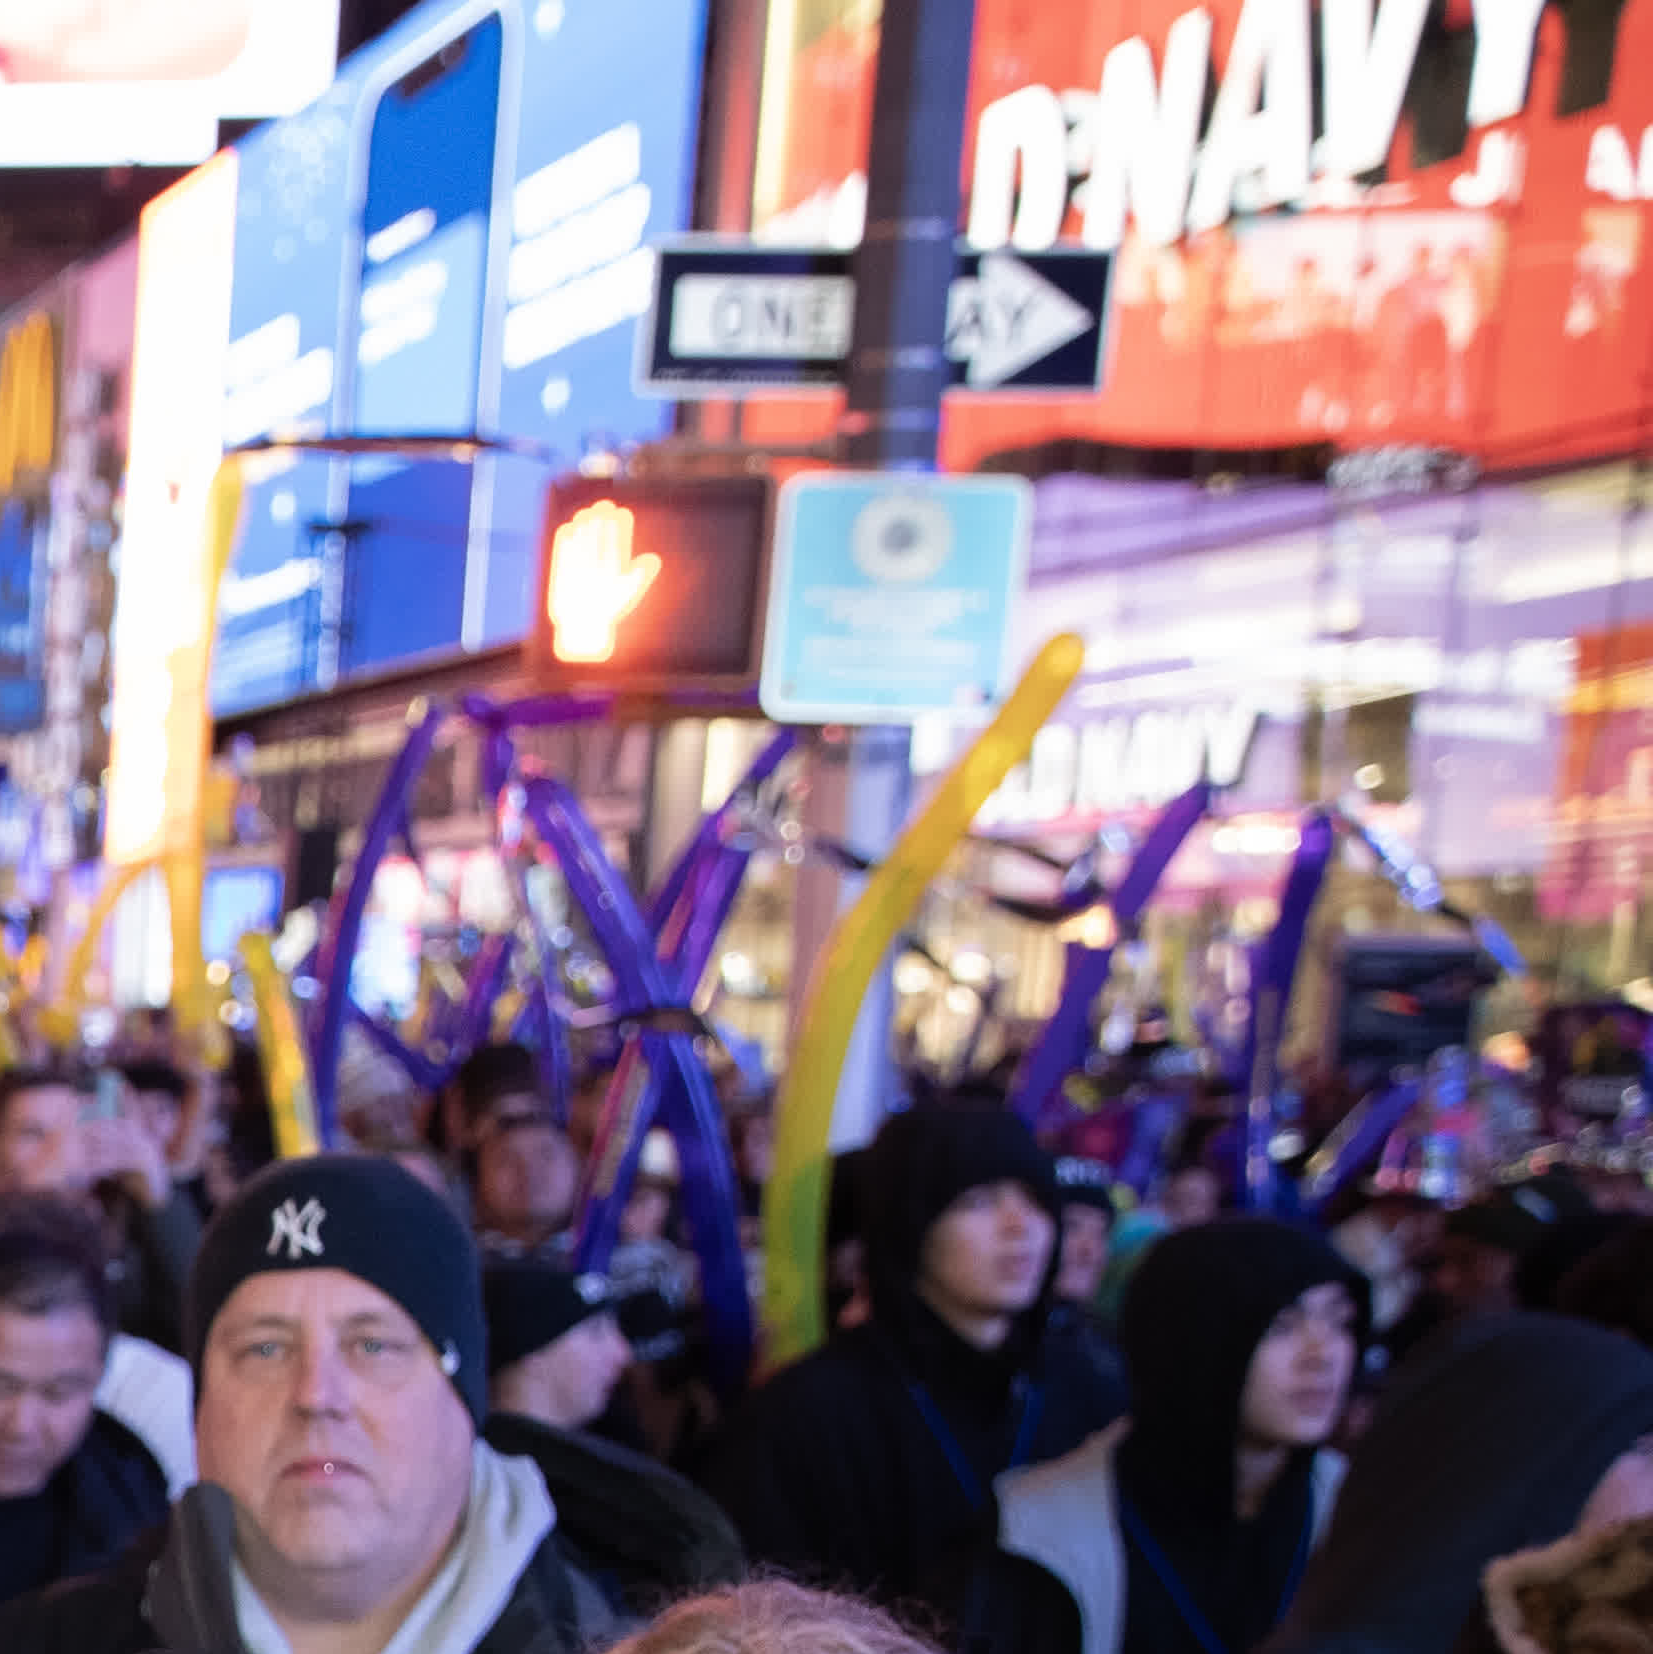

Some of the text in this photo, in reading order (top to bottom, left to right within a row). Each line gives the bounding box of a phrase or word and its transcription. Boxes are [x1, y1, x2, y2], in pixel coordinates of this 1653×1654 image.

[708, 278, 1041, 350] ONE AY
[265, 1195, 328, 1261] NY
